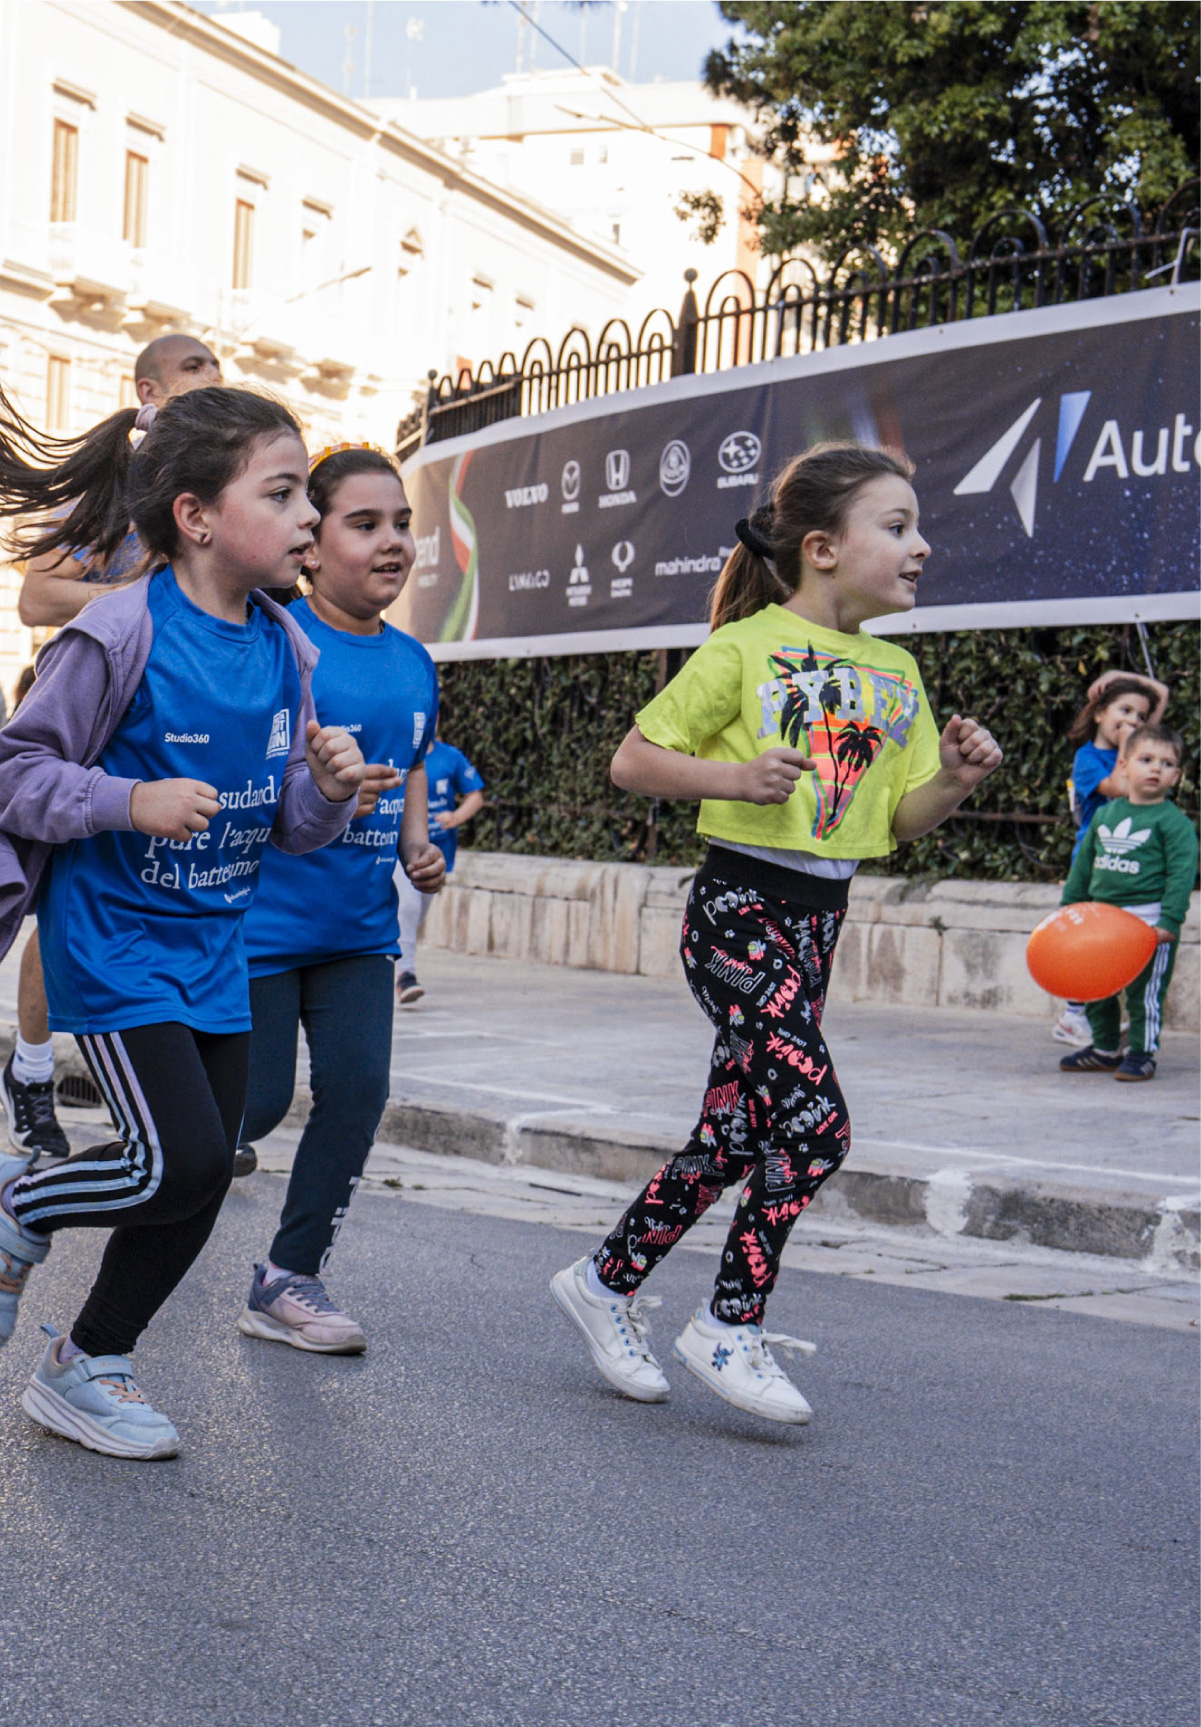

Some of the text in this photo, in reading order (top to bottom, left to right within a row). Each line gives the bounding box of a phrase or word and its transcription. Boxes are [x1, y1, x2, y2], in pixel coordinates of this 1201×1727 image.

[1083, 412, 1201, 482] Aut
[655, 554, 721, 577] mahindra
[164, 732, 210, 744] Studio360
[218, 821, 272, 854] l'acqu
[140, 861, 181, 889] del
